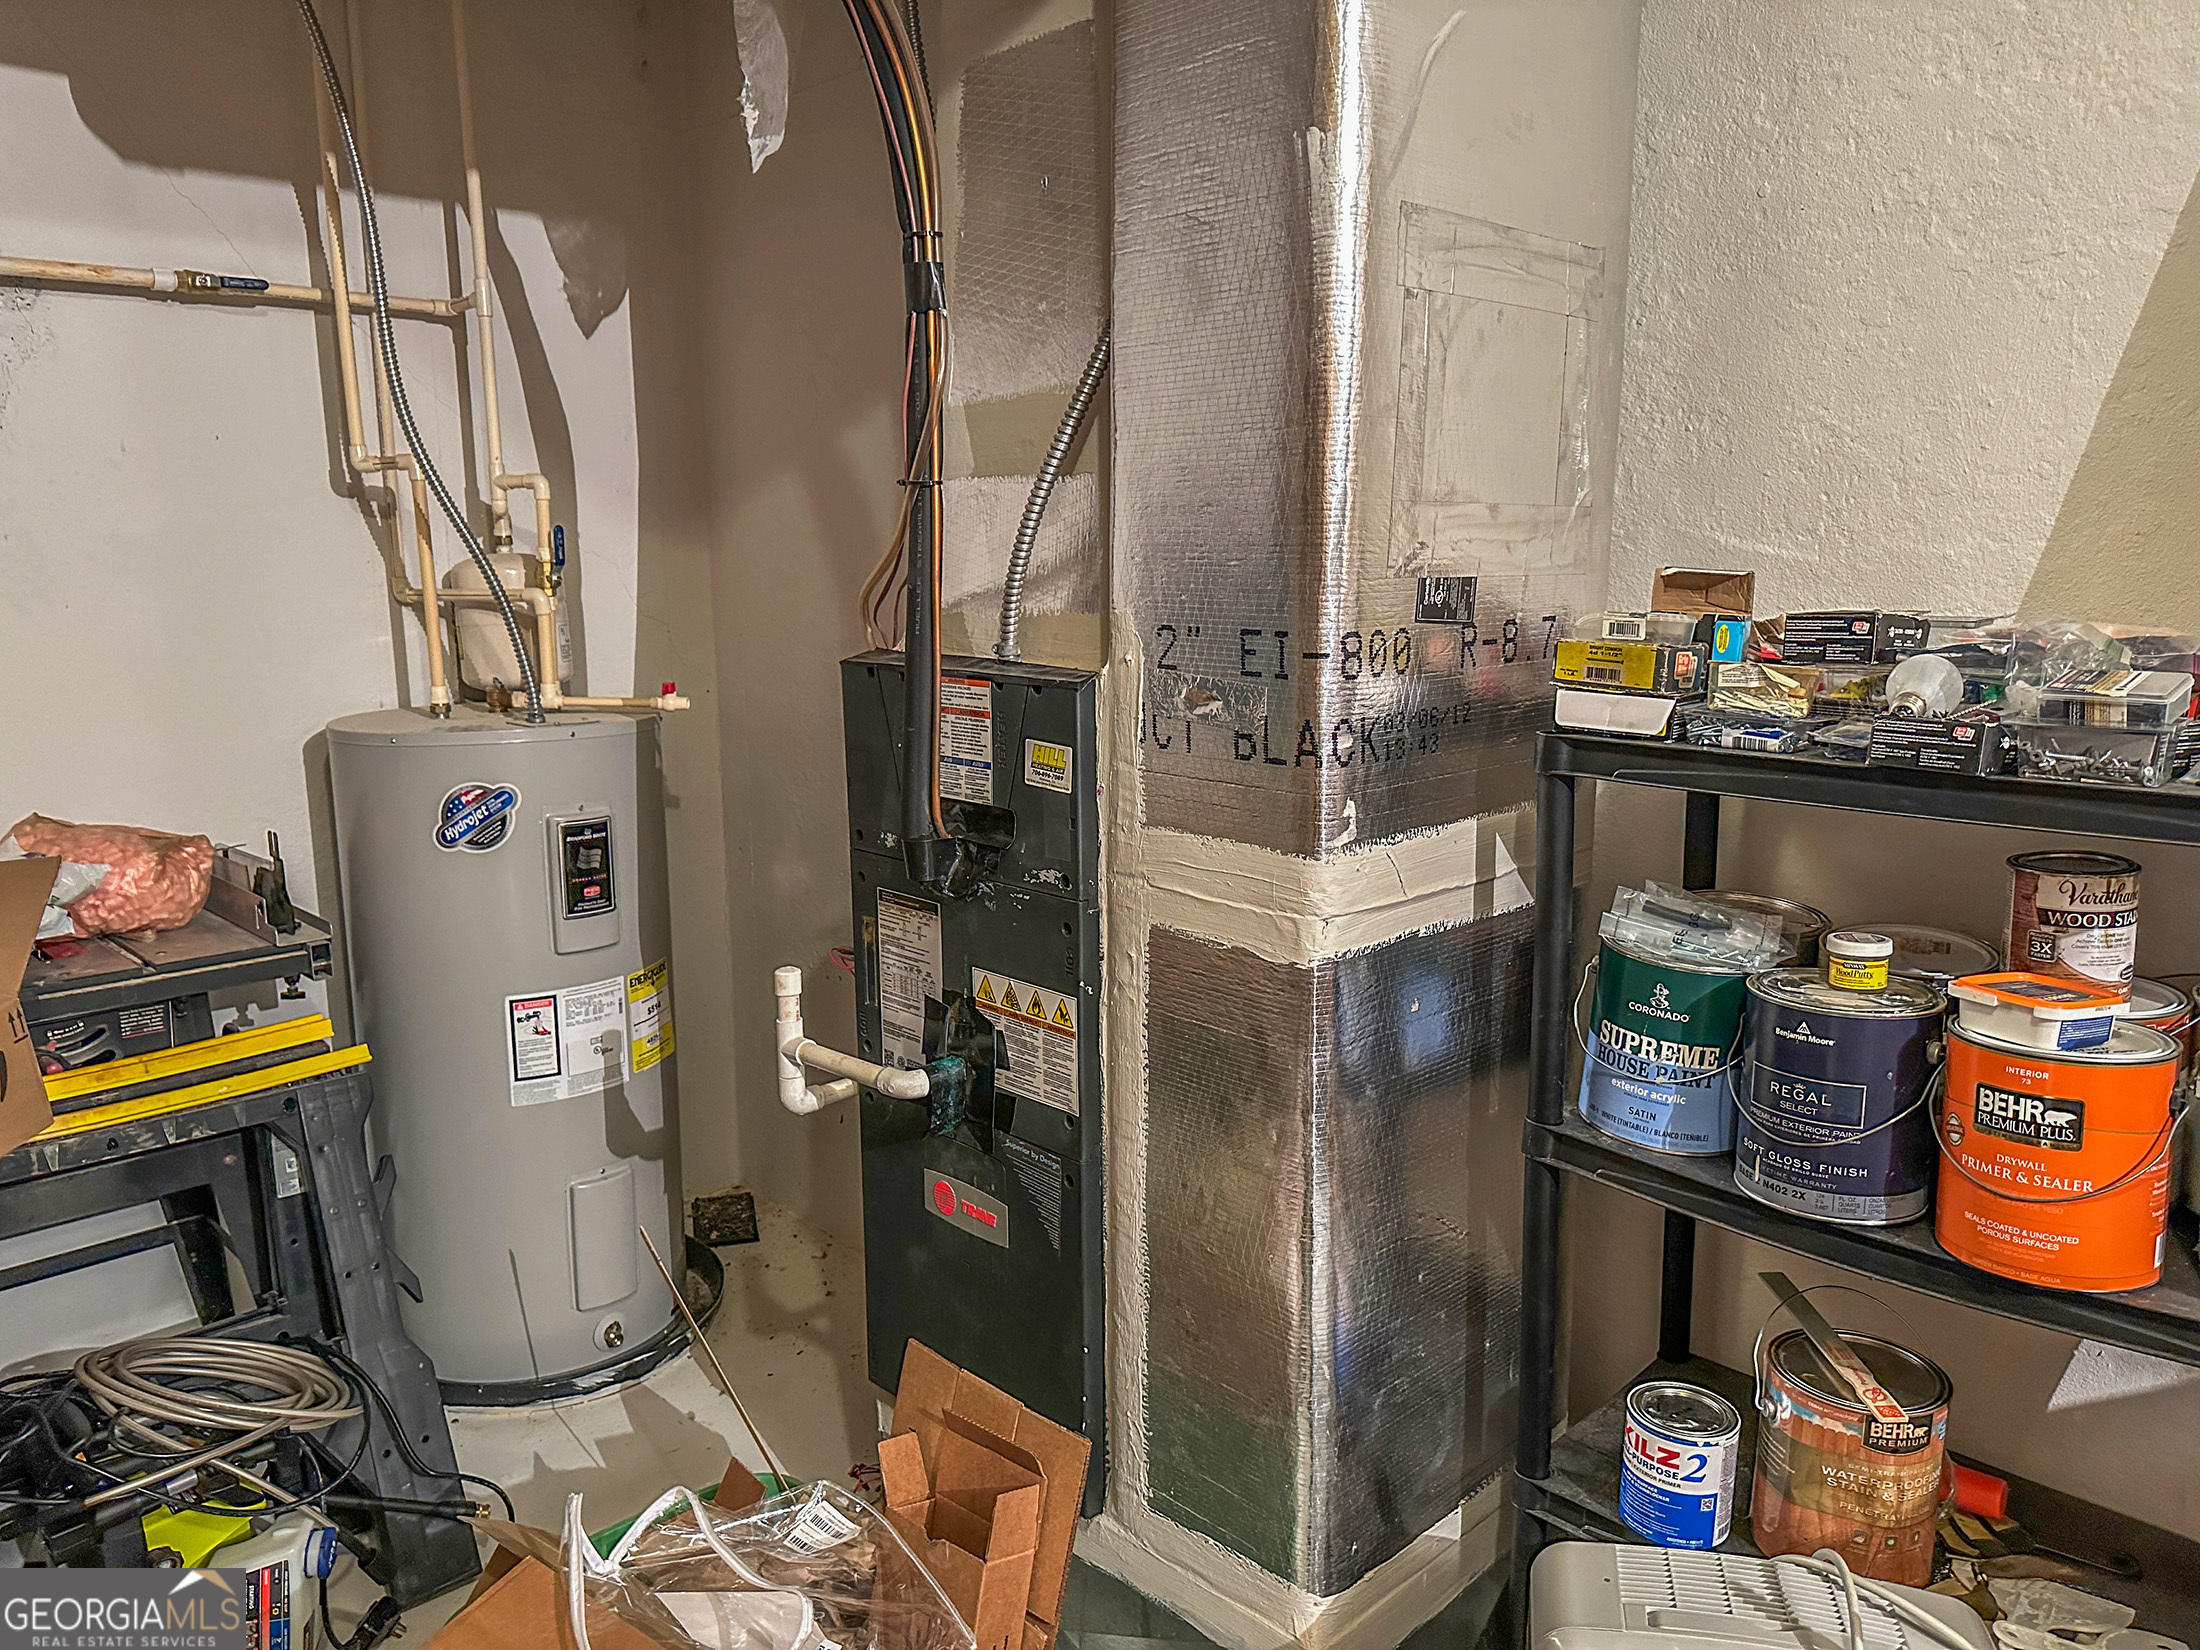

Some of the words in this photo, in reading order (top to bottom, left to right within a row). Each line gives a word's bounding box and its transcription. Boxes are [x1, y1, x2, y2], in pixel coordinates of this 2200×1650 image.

[1157, 625, 1201, 671] 2"
[1460, 616, 1557, 669] R-8.7
[1032, 744, 1067, 768] HILL
[444, 804, 489, 841] Hydrojet
[2047, 911, 2112, 928] WOOD
[2030, 941, 2053, 954] 3X
[1836, 967, 1853, 978] Wood
[1853, 969, 1874, 980] Putty
[1628, 1000, 1691, 1023] CORONADO
[1600, 1019, 1721, 1070] SUPREME
[1775, 1027, 1807, 1042] Benjamin
[1808, 1035, 1836, 1047] Moore
[1598, 1043, 1650, 1080] HOUSE
[1655, 1065, 1716, 1090] PAINT
[2005, 1066, 2049, 1080] INTERIOR
[1611, 1077, 1649, 1098] exterior
[1651, 1091, 1687, 1105] acrylic
[1770, 1081, 1832, 1107] REGAL
[1628, 1106, 1657, 1122] SATIN
[1779, 1100, 1819, 1116] SELECT
[1978, 1087, 2044, 1125] BEHR
[1750, 1106, 1780, 1124] PREMIUM
[1781, 1120, 1830, 1137] EXTERIOR
[1977, 1111, 2035, 1136] PREMIUM
[1654, 1129, 1679, 1140] BLANCO
[1002, 1138, 1030, 1156] Superior
[1030, 1150, 1039, 1161] by
[1039, 1154, 1061, 1169] Design
[1743, 1137, 1765, 1155] SOFT
[1768, 1150, 1811, 1170] GLOSS
[1819, 1164, 1868, 1178] FINISH
[1996, 1154, 2046, 1172] DRYWALL
[1790, 1175, 1837, 1190] WARRANTY
[1961, 1154, 2012, 1181] PRIMER
[2016, 1172, 2030, 1185] &
[2033, 1174, 2093, 1193] SEALER
[1762, 1179, 1788, 1196] N402
[1791, 1189, 1806, 1201] 2X
[961, 1199, 998, 1228] TRANE
[1964, 1211, 1985, 1225] SEALS
[1987, 1219, 2020, 1235] COATED
[2022, 1229, 2028, 1237] &
[2030, 1231, 2079, 1245] UNCOATED
[1977, 1225, 2010, 1241] POROUS
[2012, 1235, 2060, 1251] SURFACES
[1869, 1437, 1928, 1447] PREMIUM
[1870, 1422, 1914, 1439] BEHR
[1658, 1477, 1681, 1489] PRIMER
[1826, 1477, 1877, 1498] STAIN
[1882, 1492, 1895, 1502] &
